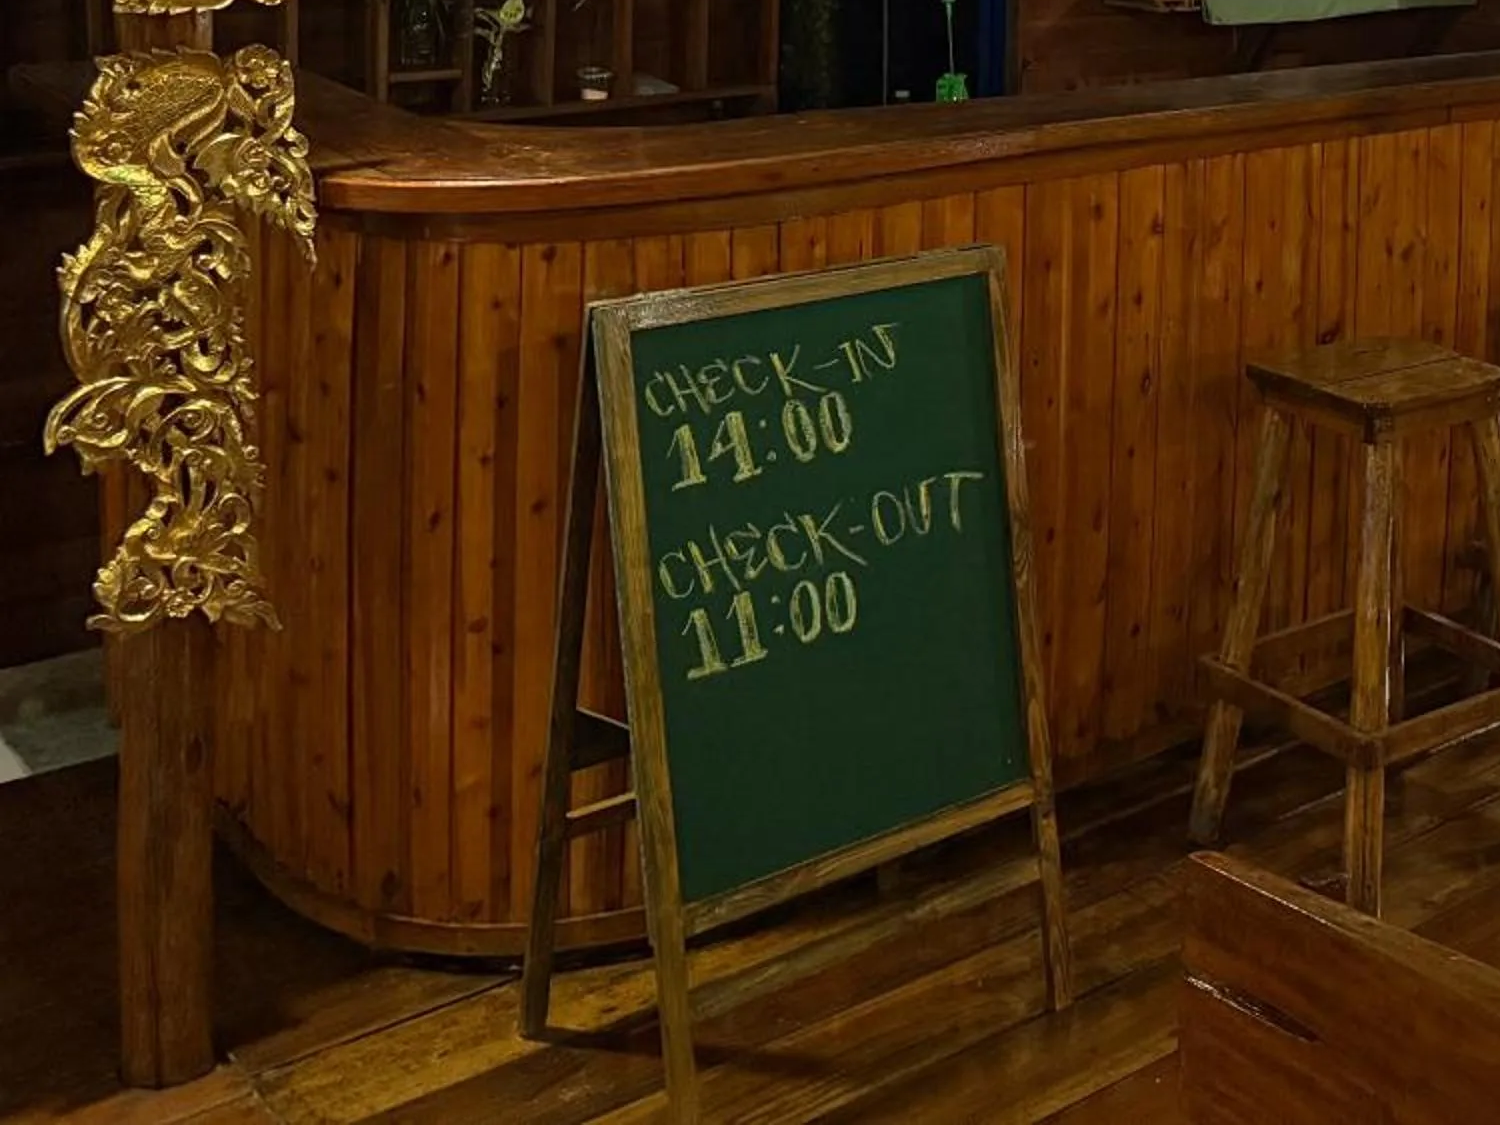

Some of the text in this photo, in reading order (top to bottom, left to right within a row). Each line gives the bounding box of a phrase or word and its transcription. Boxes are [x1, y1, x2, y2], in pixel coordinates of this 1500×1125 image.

[645, 324, 897, 416] CHECK-IN
[666, 392, 853, 491] 14:00
[659, 473, 984, 598] CHECK-OUT
[682, 571, 858, 679] 11:00
